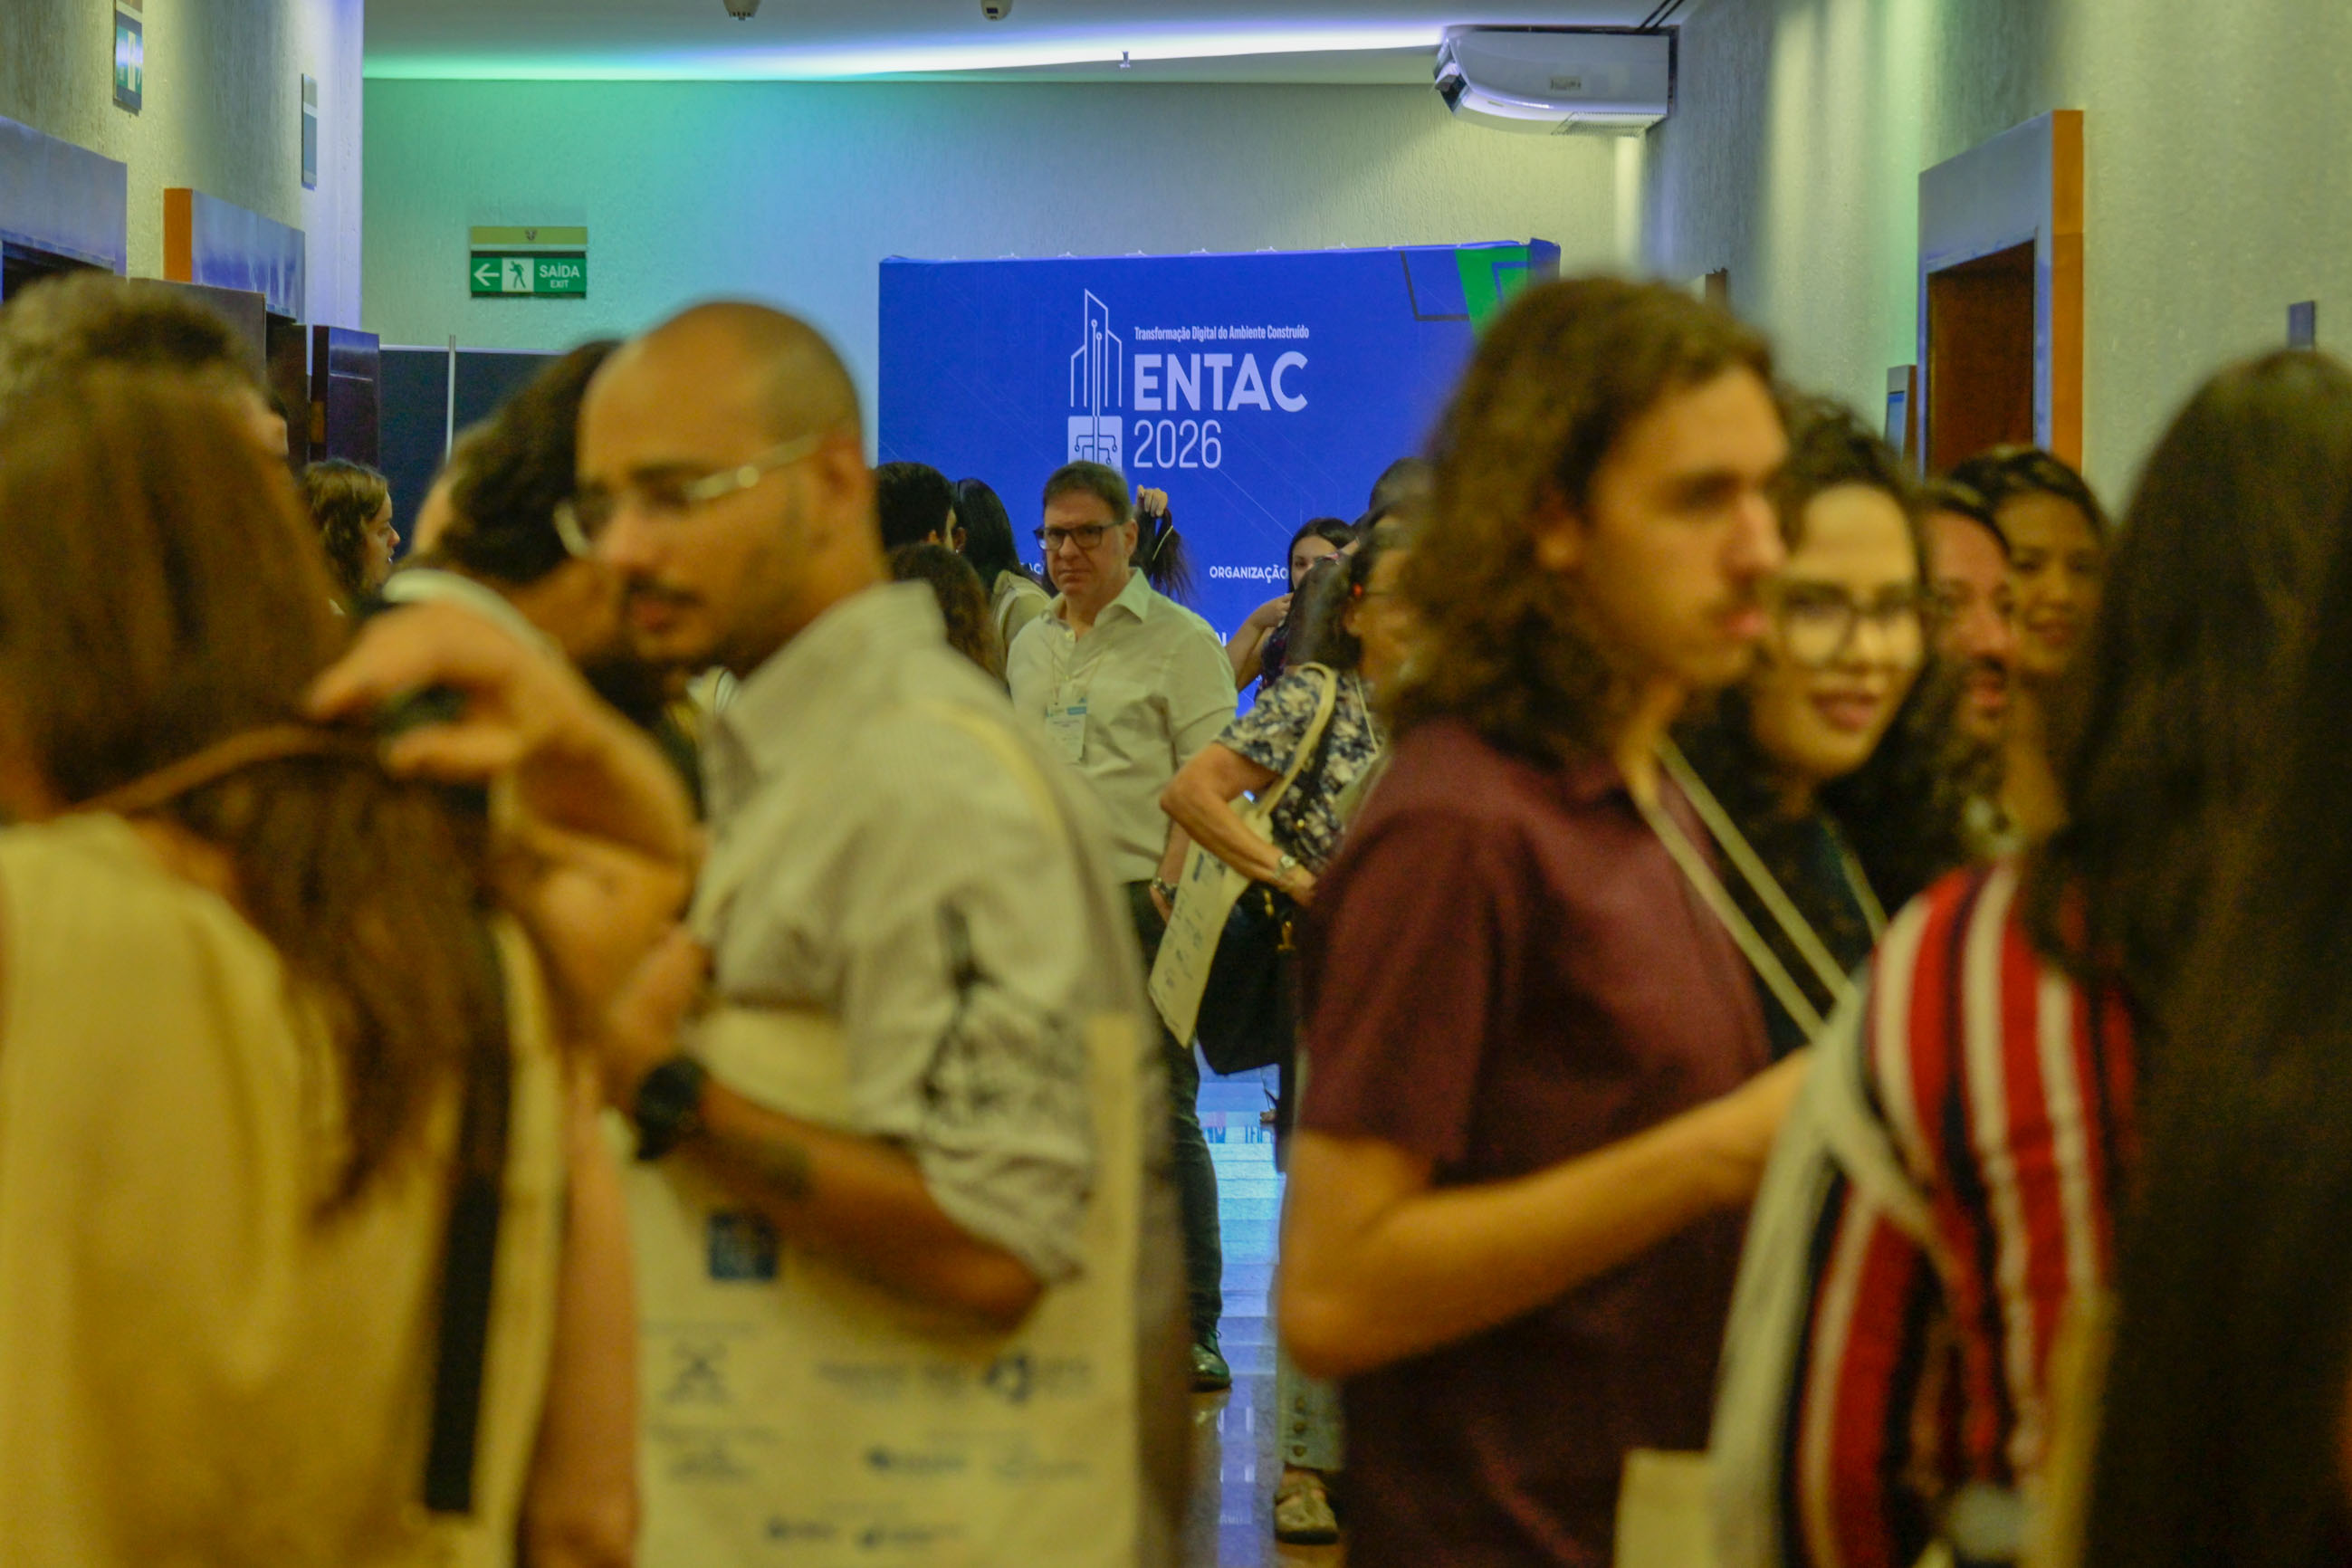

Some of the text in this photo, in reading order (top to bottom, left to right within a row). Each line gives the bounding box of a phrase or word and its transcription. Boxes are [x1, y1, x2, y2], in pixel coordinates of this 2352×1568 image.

[539, 263, 580, 278] SAÍDA
[550, 280, 569, 288] EXIT
[1134, 324, 1309, 341] Transformação Digital do Ambiente Construído
[1134, 350, 1308, 412] ENTAC
[1133, 419, 1221, 468] 2026
[1209, 564, 1289, 584] ORGANIZAÇÃO
